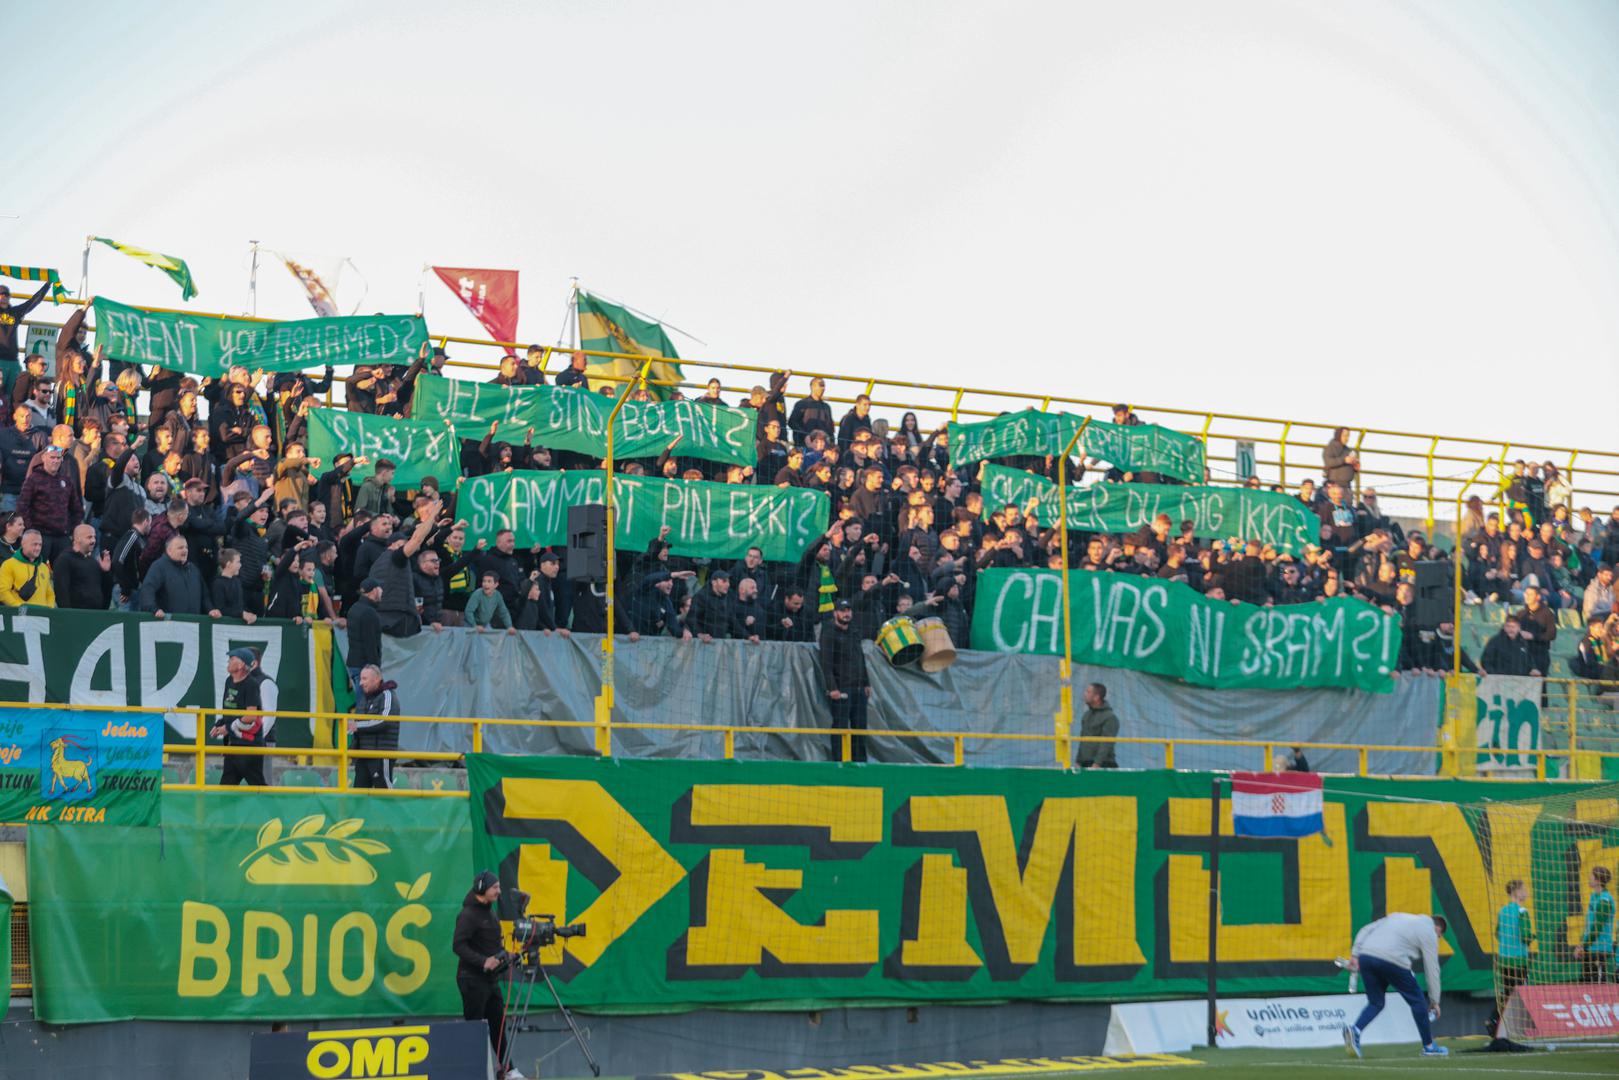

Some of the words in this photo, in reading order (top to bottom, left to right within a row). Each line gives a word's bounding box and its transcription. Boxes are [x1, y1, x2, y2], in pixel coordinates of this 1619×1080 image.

[106, 310, 199, 372] AREN'T
[274, 318, 417, 364] ASHAMED?
[436, 378, 486, 424] JEL
[621, 400, 749, 457] BOLAN?
[728, 490, 817, 547] EKKI?
[1126, 488, 1160, 528] DU
[992, 572, 1064, 654] CA
[1092, 576, 1169, 659] VAS
[1188, 603, 1226, 678] NI
[1239, 606, 1391, 679] SRAM?!
[0, 743, 22, 765] oje
[102, 770, 158, 792] TRVIŠKI
[25, 805, 52, 822] NK
[59, 805, 107, 823] ISTRA
[177, 872, 432, 998] BRIOŠ
[1246, 1003, 1310, 1022] uniline
[1312, 1008, 1346, 1021] group
[1571, 993, 1619, 1028] air
[306, 1035, 430, 1079] OMP
